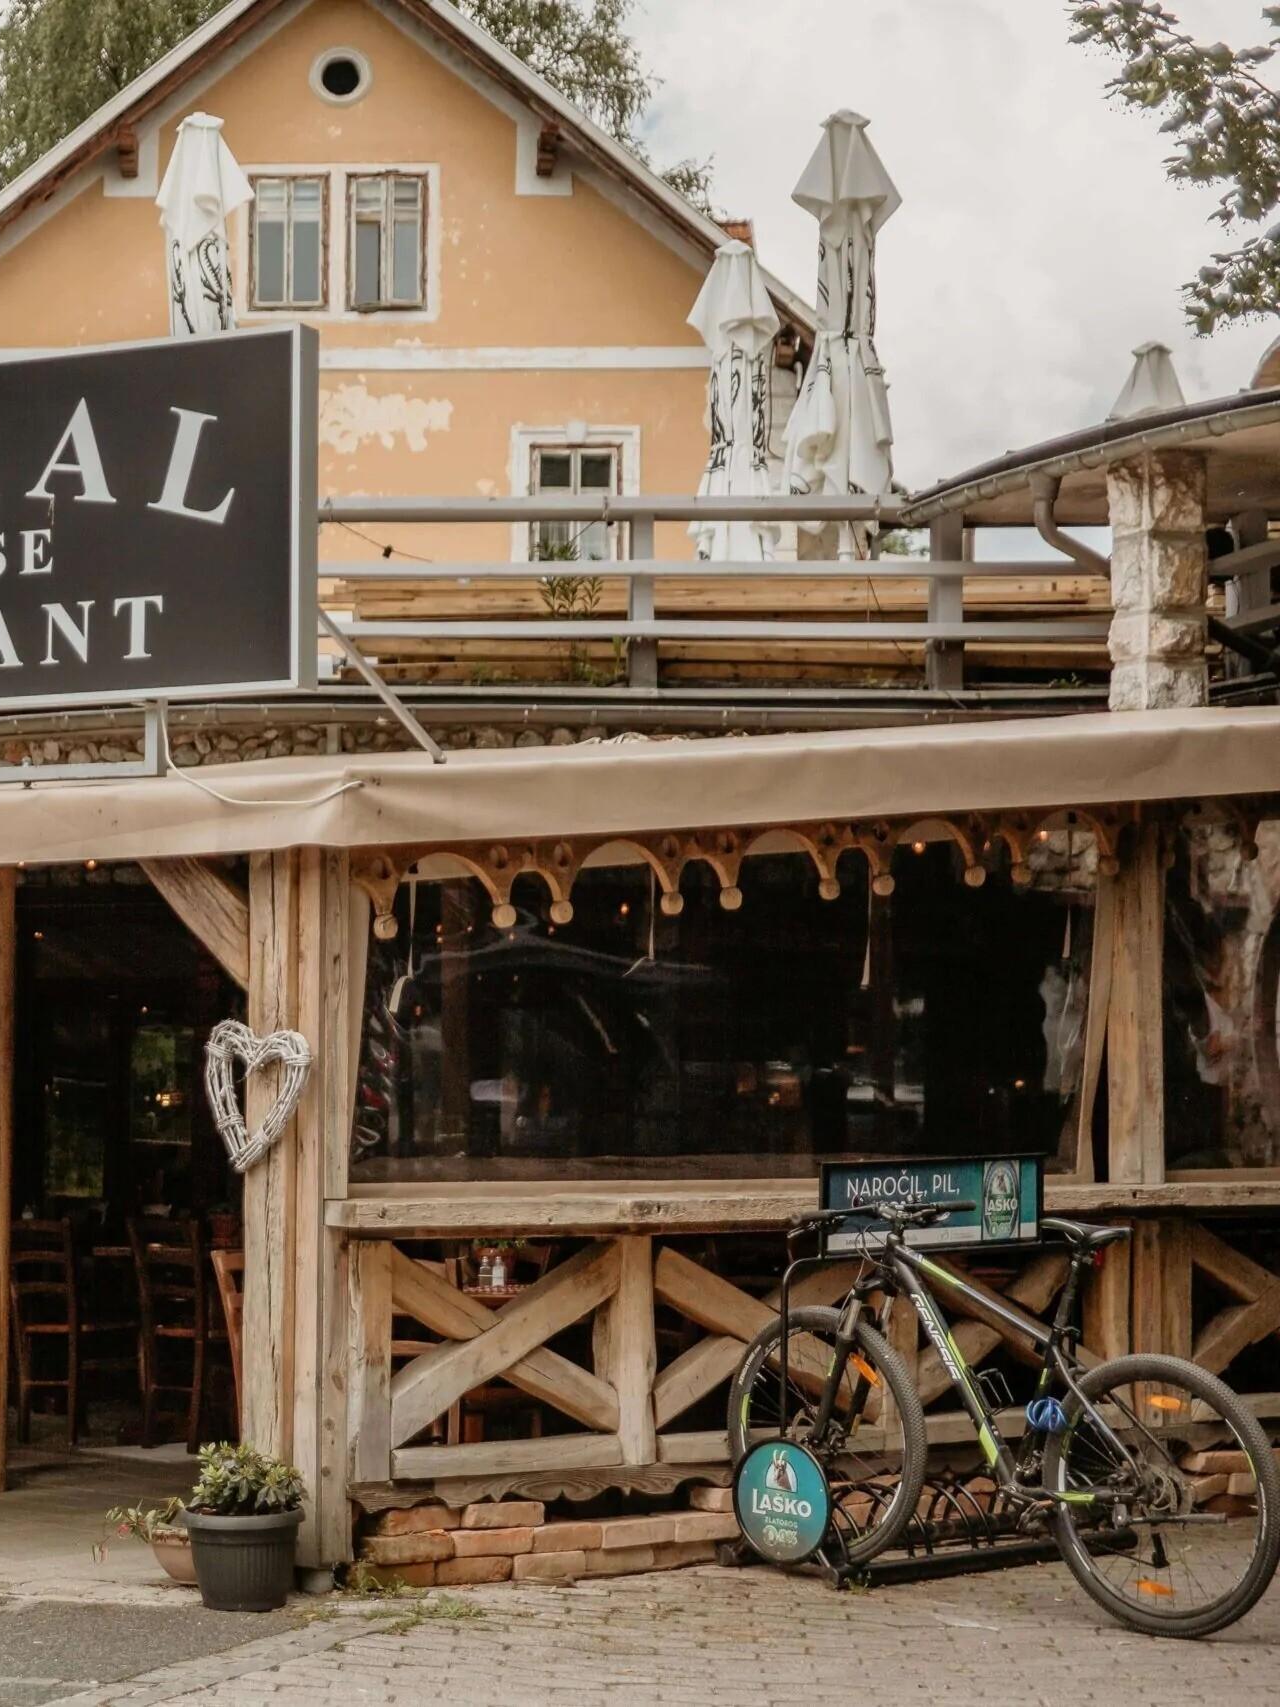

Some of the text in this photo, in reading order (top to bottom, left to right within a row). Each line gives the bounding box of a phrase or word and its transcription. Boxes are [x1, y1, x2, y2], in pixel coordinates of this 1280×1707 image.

[846, 1169, 961, 1198] NAROČIL, PIL,
[752, 1488, 812, 1518] LAŠKO
